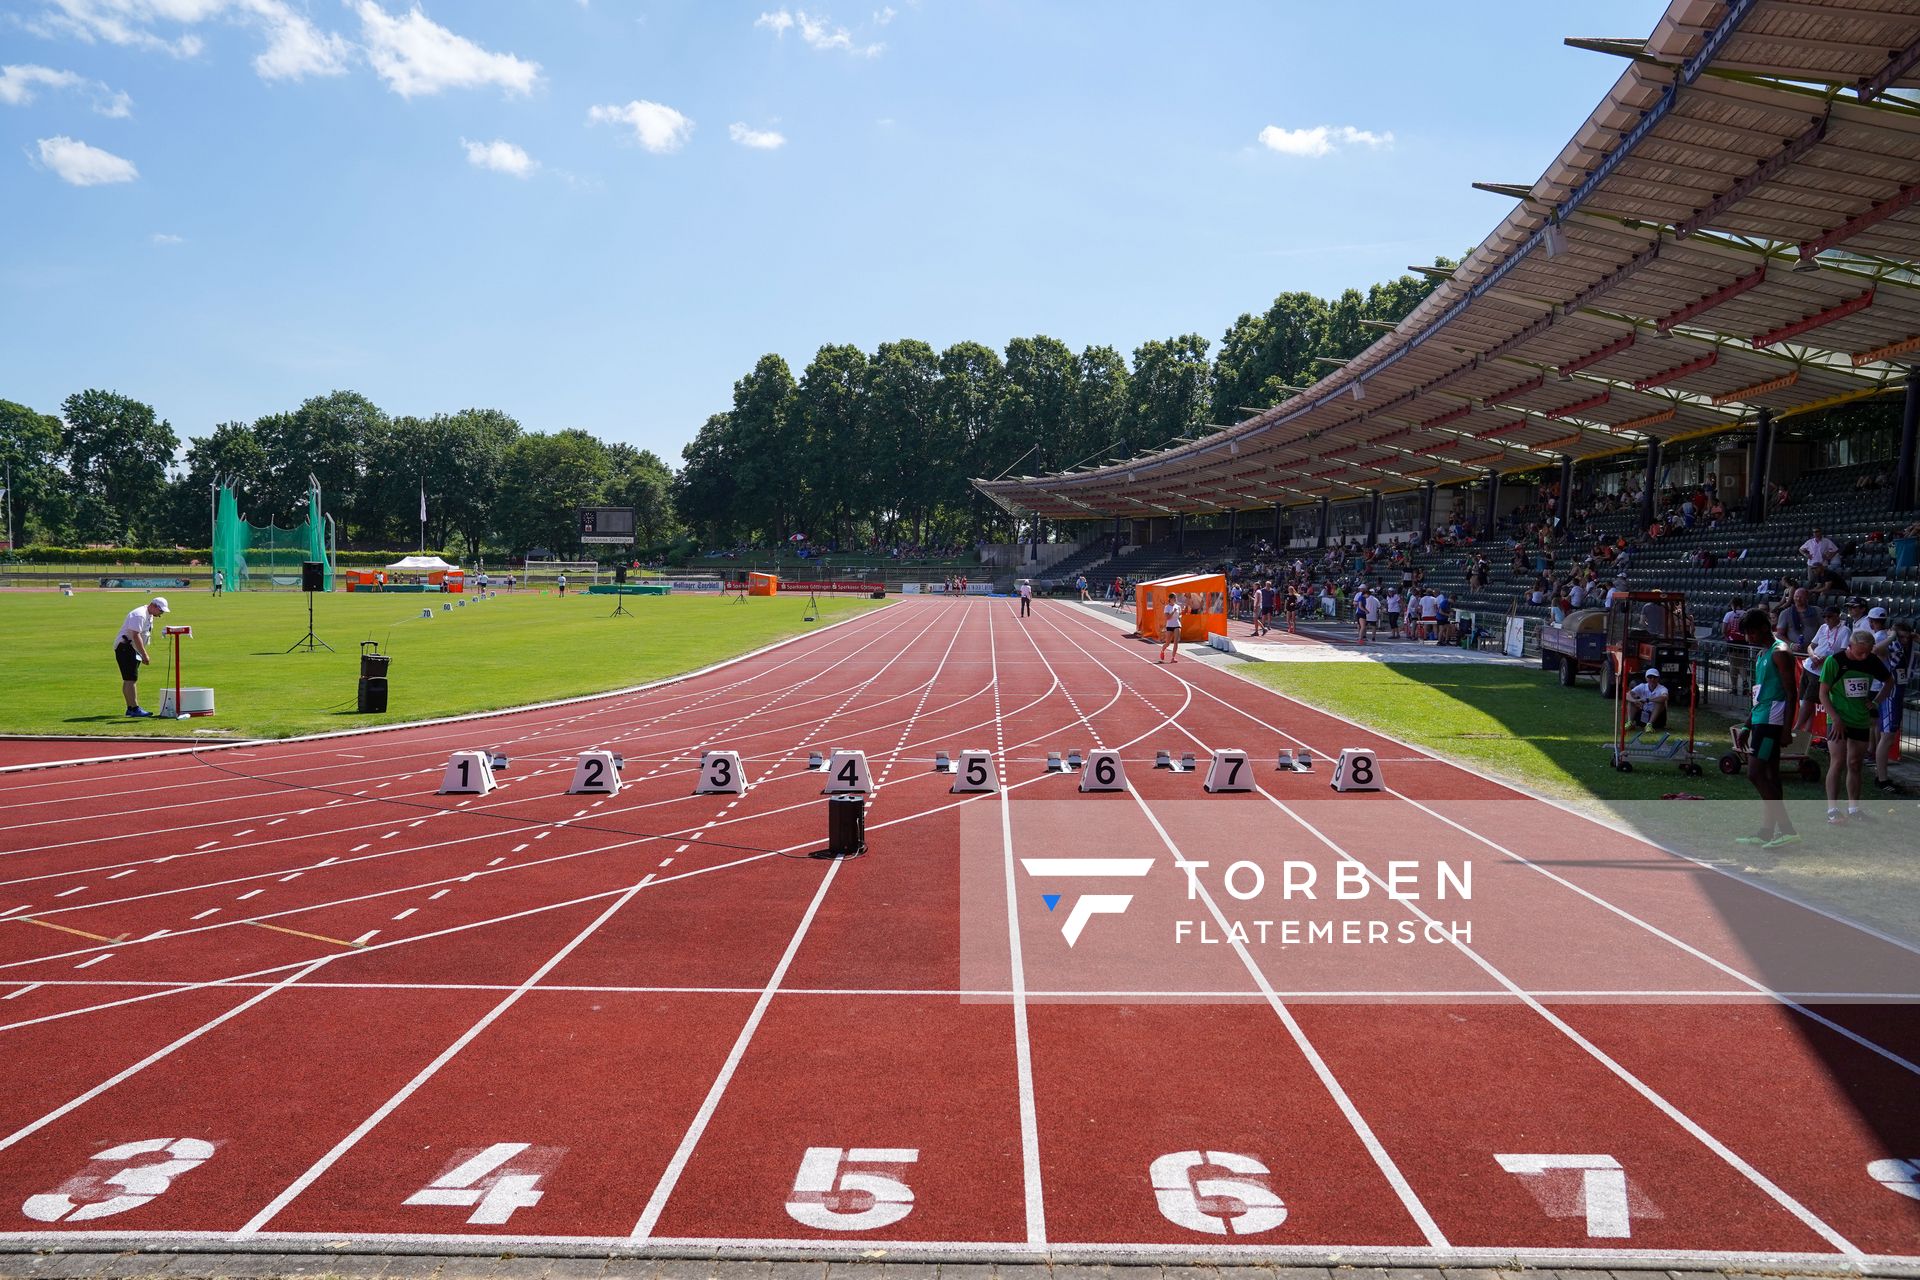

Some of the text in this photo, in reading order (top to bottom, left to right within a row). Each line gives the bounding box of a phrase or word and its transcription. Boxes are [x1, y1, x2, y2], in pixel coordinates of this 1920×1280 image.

[1725, 475, 1735, 487] D
[423, 609, 431, 617] 70
[457, 760, 469, 787] 1
[584, 759, 604, 786] 2
[710, 758, 731, 787] 3
[837, 759, 859, 786] 4
[966, 758, 987, 785] 5
[1095, 756, 1115, 785] 6
[1224, 758, 1243, 785] 7
[1335, 754, 1345, 782] 8
[1352, 756, 1373, 784] 8
[22, 1138, 215, 1222] 3
[401, 1143, 544, 1224] 4
[785, 1147, 919, 1231] 5
[1149, 1150, 1288, 1235] 6
[1493, 1154, 1631, 1238] 7
